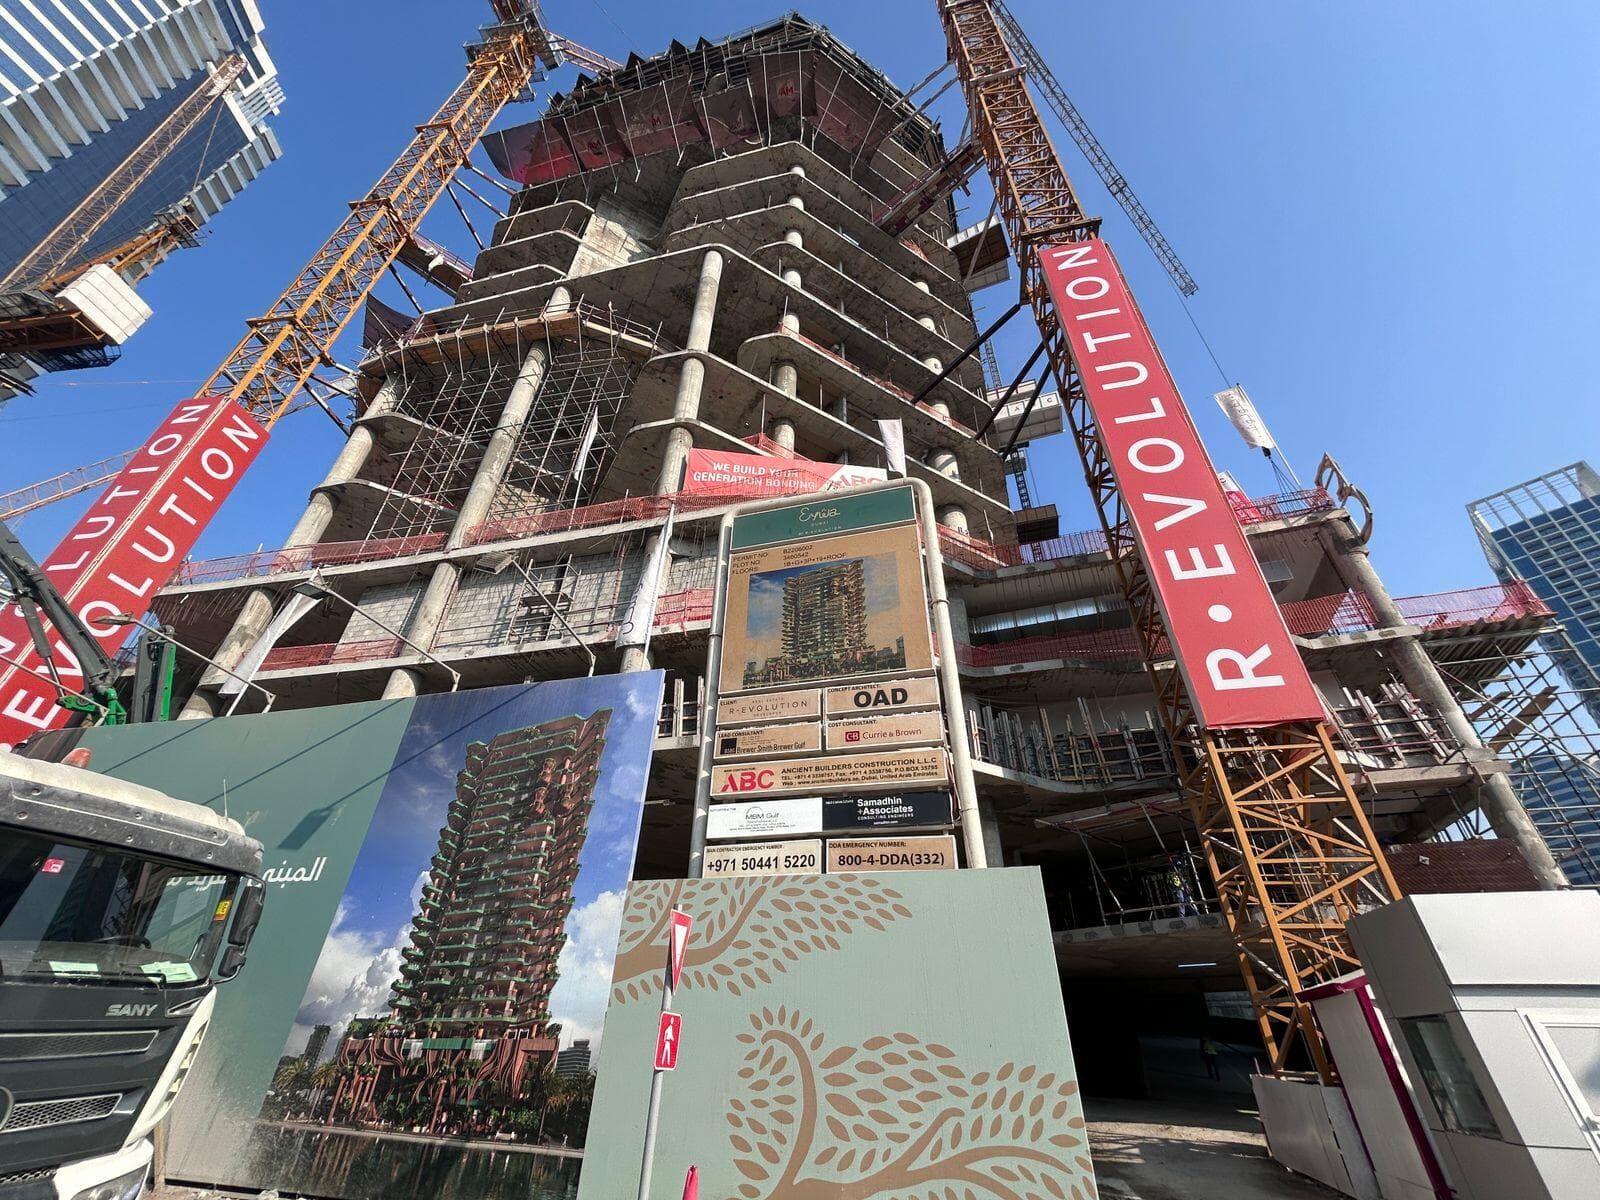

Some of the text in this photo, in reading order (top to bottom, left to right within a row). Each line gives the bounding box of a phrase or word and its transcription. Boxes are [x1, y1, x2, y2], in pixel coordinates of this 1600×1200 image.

[713, 462, 729, 472] WE
[733, 464, 766, 474] BUILD
[694, 472, 762, 487] GENERATION
[854, 688, 908, 708] OAD
[862, 730, 888, 740] Currie
[896, 728, 922, 736] Brown
[737, 746, 756, 754] Brewer
[774, 743, 794, 751] Brewer
[781, 766, 814, 774] ANCIENT
[815, 764, 852, 772] BUILDERS
[854, 758, 915, 768] CONSTRUCTION
[721, 770, 774, 792] ABC
[857, 796, 902, 806] Samadhin
[708, 854, 816, 872] +971 50441 5220
[838, 852, 944, 866] 800-4-DDA(332)
[105, 1004, 158, 1016] SANY
